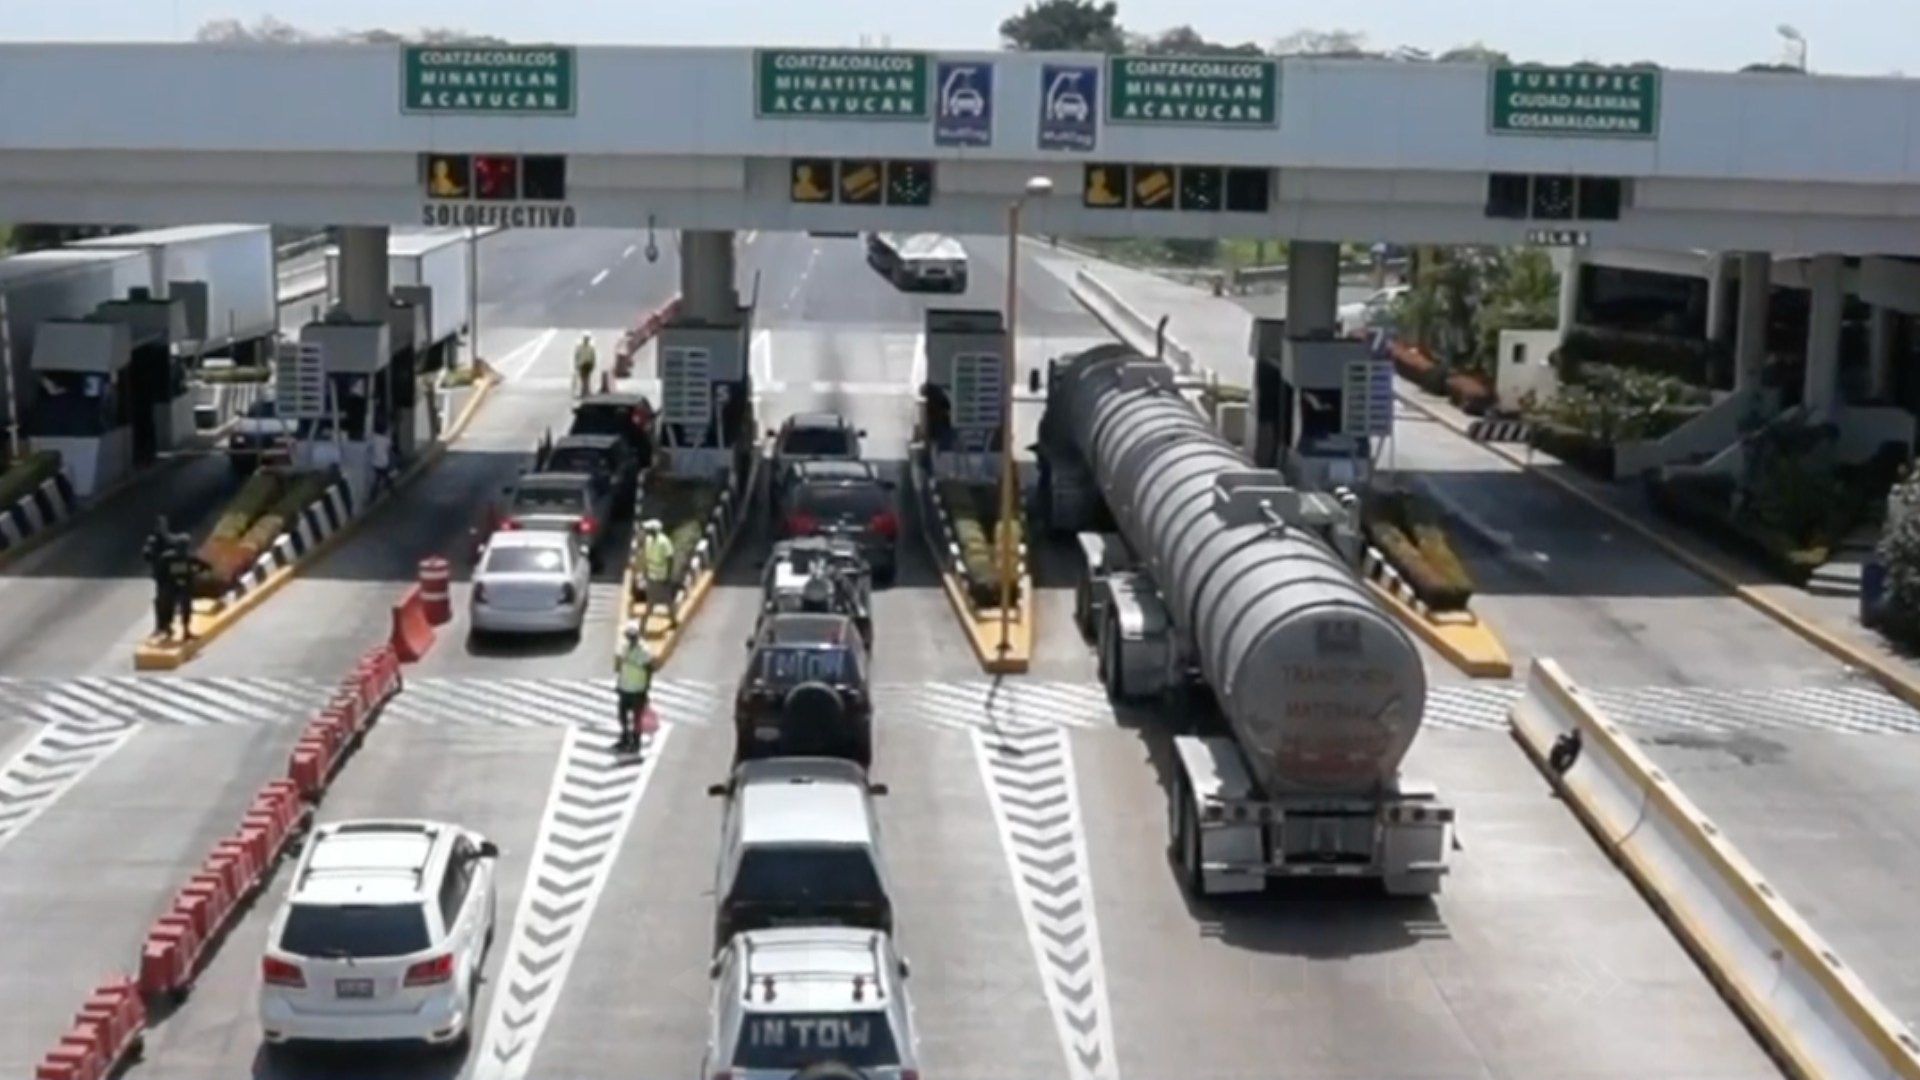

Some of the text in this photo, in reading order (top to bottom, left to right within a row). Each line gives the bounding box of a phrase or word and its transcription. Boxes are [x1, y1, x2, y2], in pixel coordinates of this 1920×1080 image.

[419, 52, 558, 67] COATZACOALCOS
[774, 54, 914, 71] COATZACOALCOS
[1125, 61, 1263, 78] COATZACOALCOS
[420, 71, 558, 87] MINATITLAN
[775, 75, 914, 92] MINATITLAN
[1511, 72, 1641, 91] TUXTEPEC
[1125, 81, 1262, 99] MINATITLAN
[420, 91, 557, 107] ACAYUCAN
[774, 96, 914, 113] ACAYUCAN
[1509, 92, 1641, 111] CIUDAD ALEMAN
[1125, 102, 1262, 120] ACAYUCAN
[1508, 112, 1640, 130] COSAMALOAPAN
[751, 1019, 871, 1047] IN TOW
